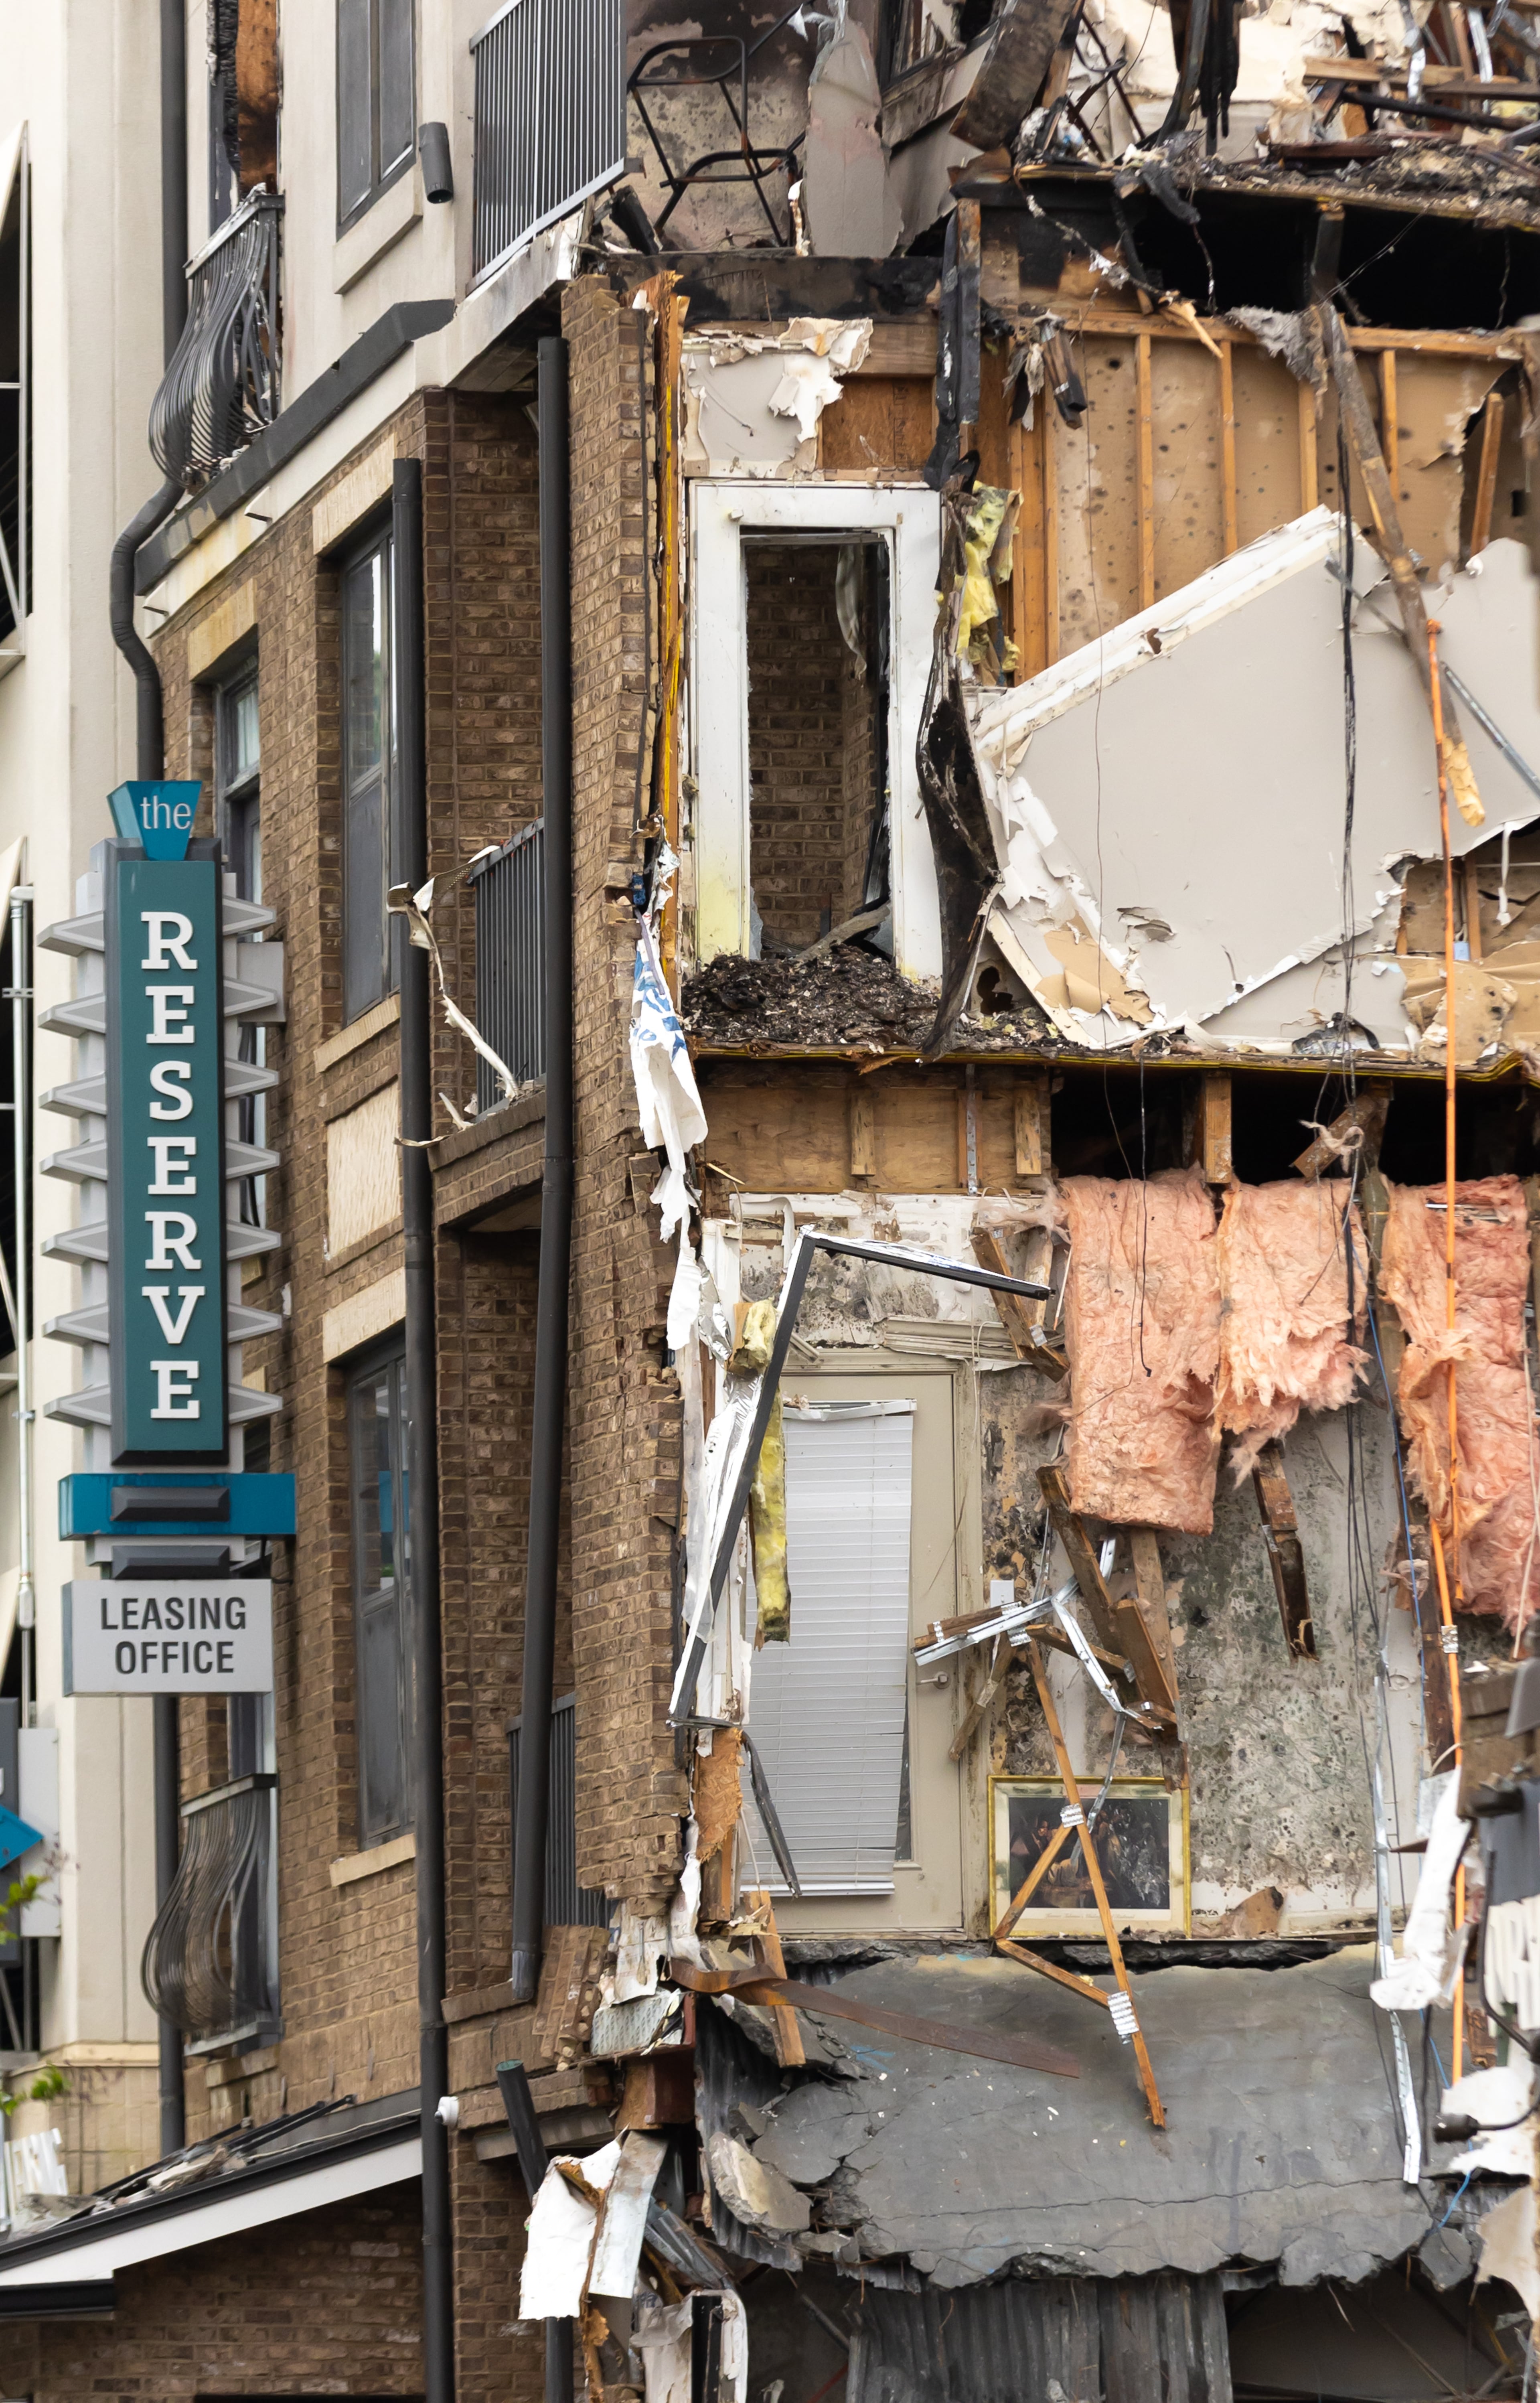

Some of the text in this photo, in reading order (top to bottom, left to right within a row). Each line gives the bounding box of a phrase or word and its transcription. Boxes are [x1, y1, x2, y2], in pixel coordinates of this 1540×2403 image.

[140, 795, 191, 829] the
[141, 911, 205, 1419] RESERVE
[101, 1597, 246, 1630] LEASING
[115, 1641, 234, 1674] OFFICE
